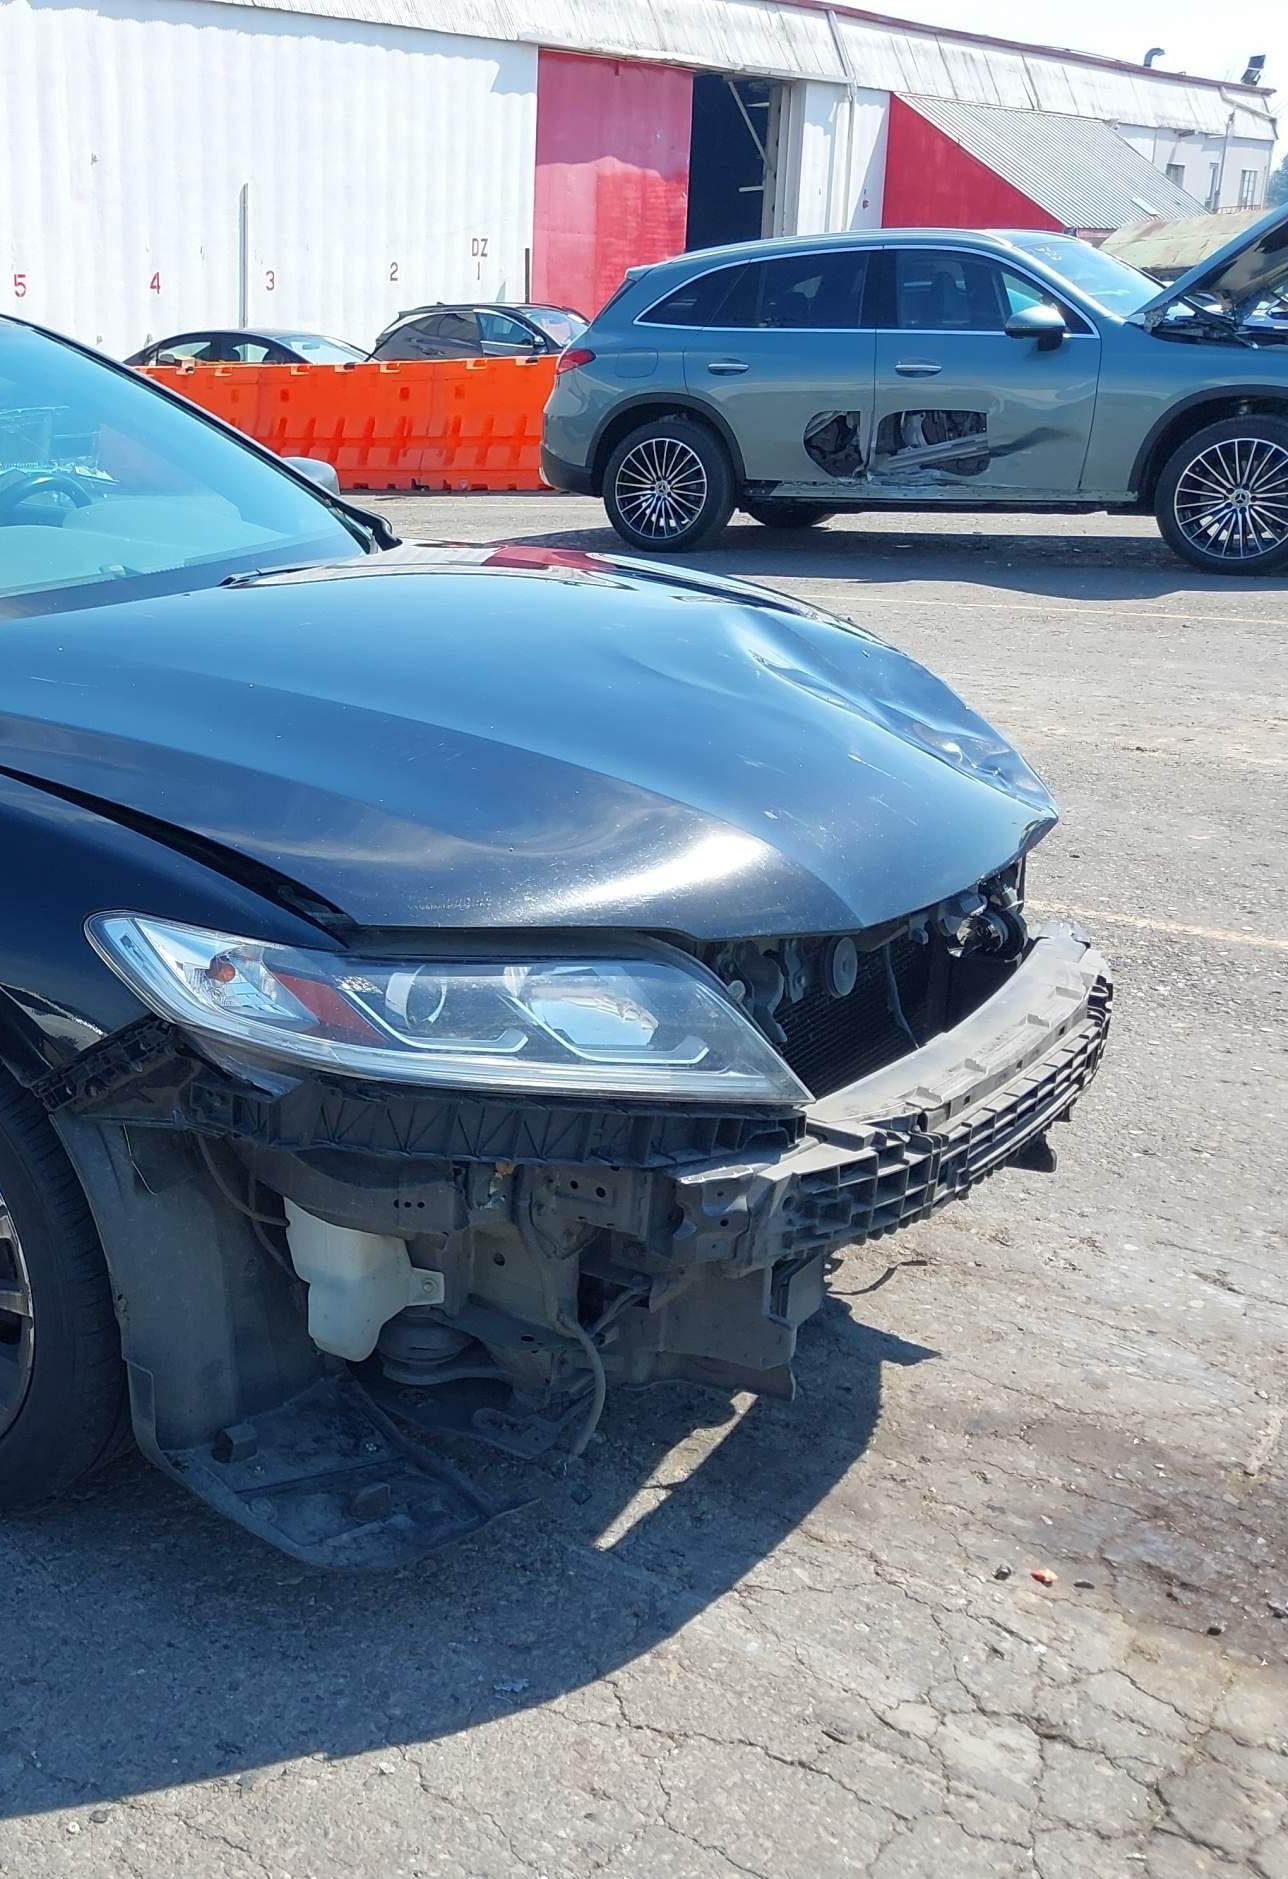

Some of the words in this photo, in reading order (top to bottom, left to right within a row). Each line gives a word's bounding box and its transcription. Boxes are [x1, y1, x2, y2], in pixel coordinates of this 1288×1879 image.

[471, 238, 489, 258] DZ
[265, 270, 275, 291] 3
[389, 261, 399, 282] 2
[14, 273, 27, 298] 5
[150, 271, 161, 295] 4
